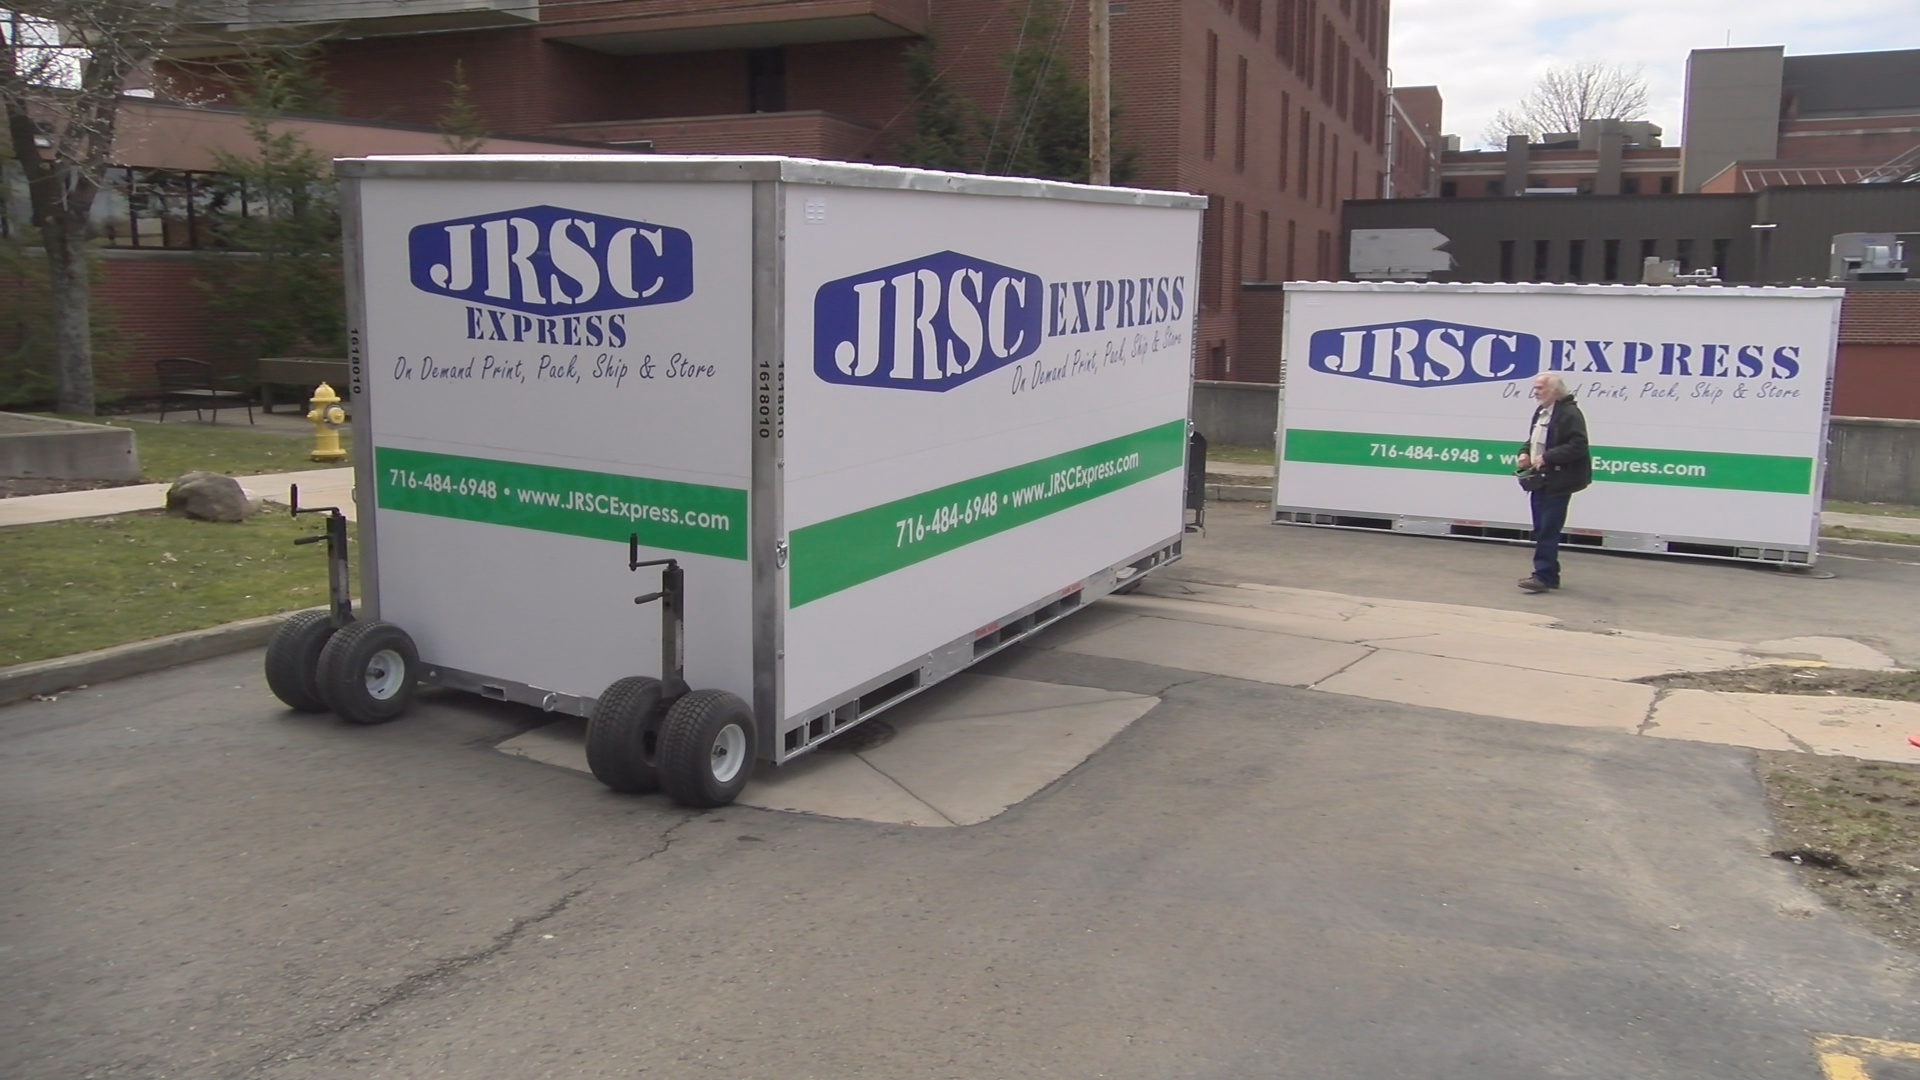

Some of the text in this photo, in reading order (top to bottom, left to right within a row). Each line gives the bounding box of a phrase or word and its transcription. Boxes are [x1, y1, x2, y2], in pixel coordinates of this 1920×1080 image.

[429, 217, 665, 305] JRSC
[465, 306, 628, 348] EXPRESS
[834, 268, 1027, 380] JRSC
[1048, 276, 1185, 338] EXPRESS
[350, 328, 361, 394] 1618010
[394, 352, 716, 388] On Demand Print, Pack, Ship & Store
[1011, 365, 1026, 395] On
[1031, 353, 1069, 390] Demand
[1324, 326, 1801, 382] JRSC EXPRESS
[759, 361, 770, 439] 1618010
[1502, 382, 1521, 399] On
[1586, 381, 1628, 402] Print,
[1639, 381, 1680, 402] Pack,
[1690, 381, 1724, 404] Ship
[1732, 382, 1748, 398] &
[1756, 383, 1803, 399] Store
[1370, 443, 1480, 463] 716-484-6948
[389, 469, 730, 531] 716-484-6948 www.JRSCExpress.com
[896, 452, 1140, 548] 716-484-6948 www.JRSCExpress.com
